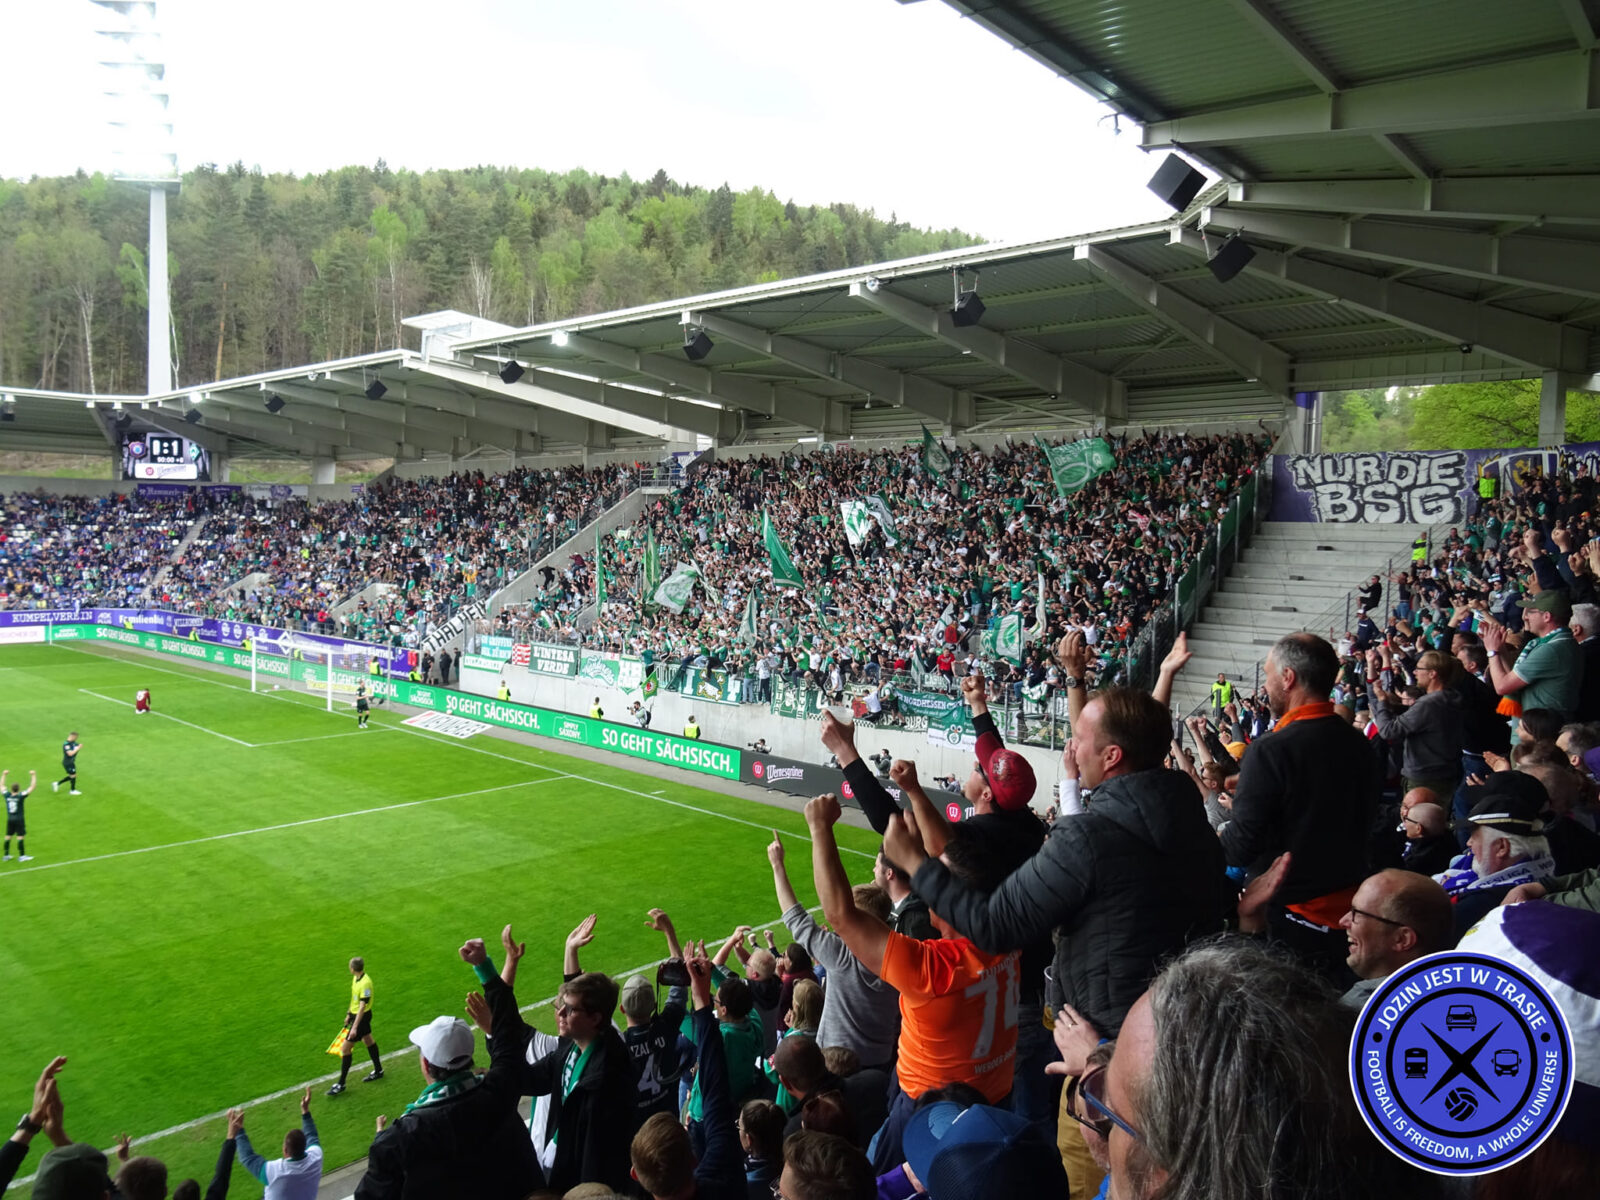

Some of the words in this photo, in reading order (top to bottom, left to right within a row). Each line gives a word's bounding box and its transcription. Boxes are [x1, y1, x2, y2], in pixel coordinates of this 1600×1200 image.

[1296, 454, 1385, 487] NUR
[1387, 451, 1465, 489] DIE
[1314, 480, 1459, 524] BSG
[537, 659, 570, 675] VERDE
[445, 695, 458, 709] SO
[458, 699, 482, 717] GEHT
[484, 702, 541, 730] SÄCHSISCH.
[602, 728, 618, 746] SO
[620, 732, 652, 755] GEHT
[656, 738, 735, 773] SÄCHSISCH.
